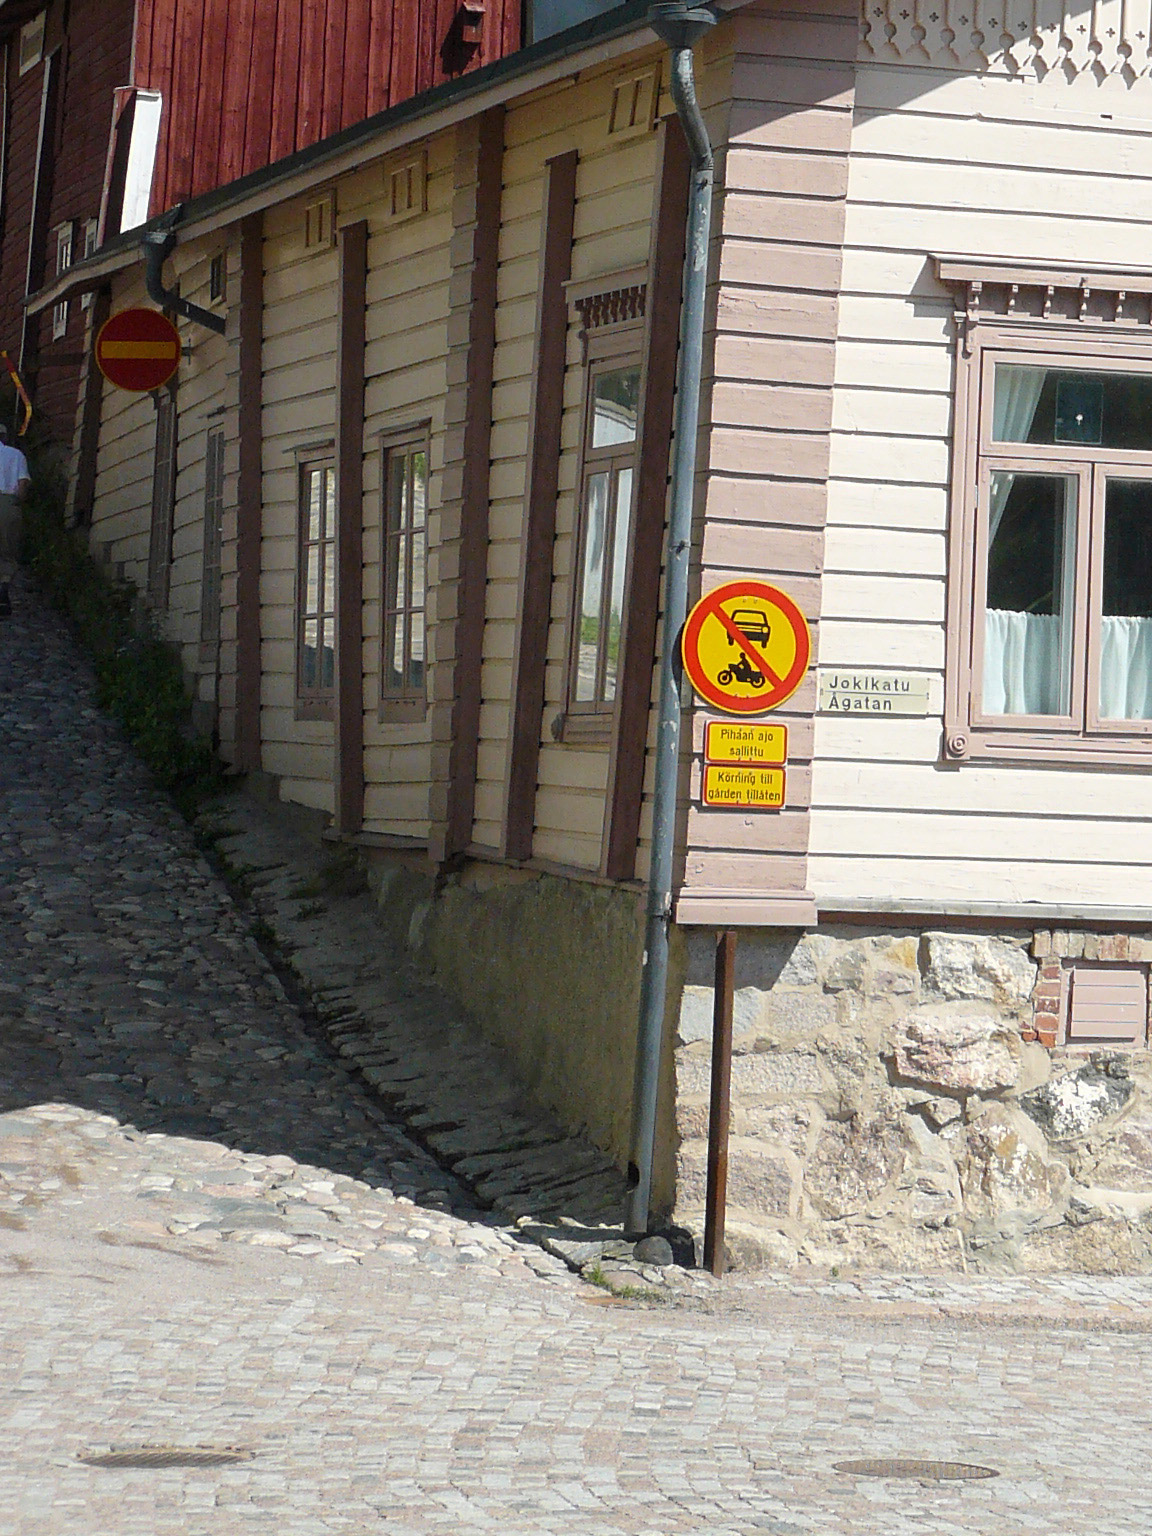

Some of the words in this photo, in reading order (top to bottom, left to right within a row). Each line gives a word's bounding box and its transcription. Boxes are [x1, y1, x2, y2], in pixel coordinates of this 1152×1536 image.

[829, 675, 910, 692] Jokikatu
[828, 692, 892, 711] Ågatan
[721, 728, 754, 741] Pihaan
[758, 731, 774, 743] ajo
[729, 745, 764, 757] sallittu
[717, 771, 756, 786] Körning
[760, 773, 773, 784] till
[708, 788, 742, 800] gården
[746, 789, 781, 801] tillåten
